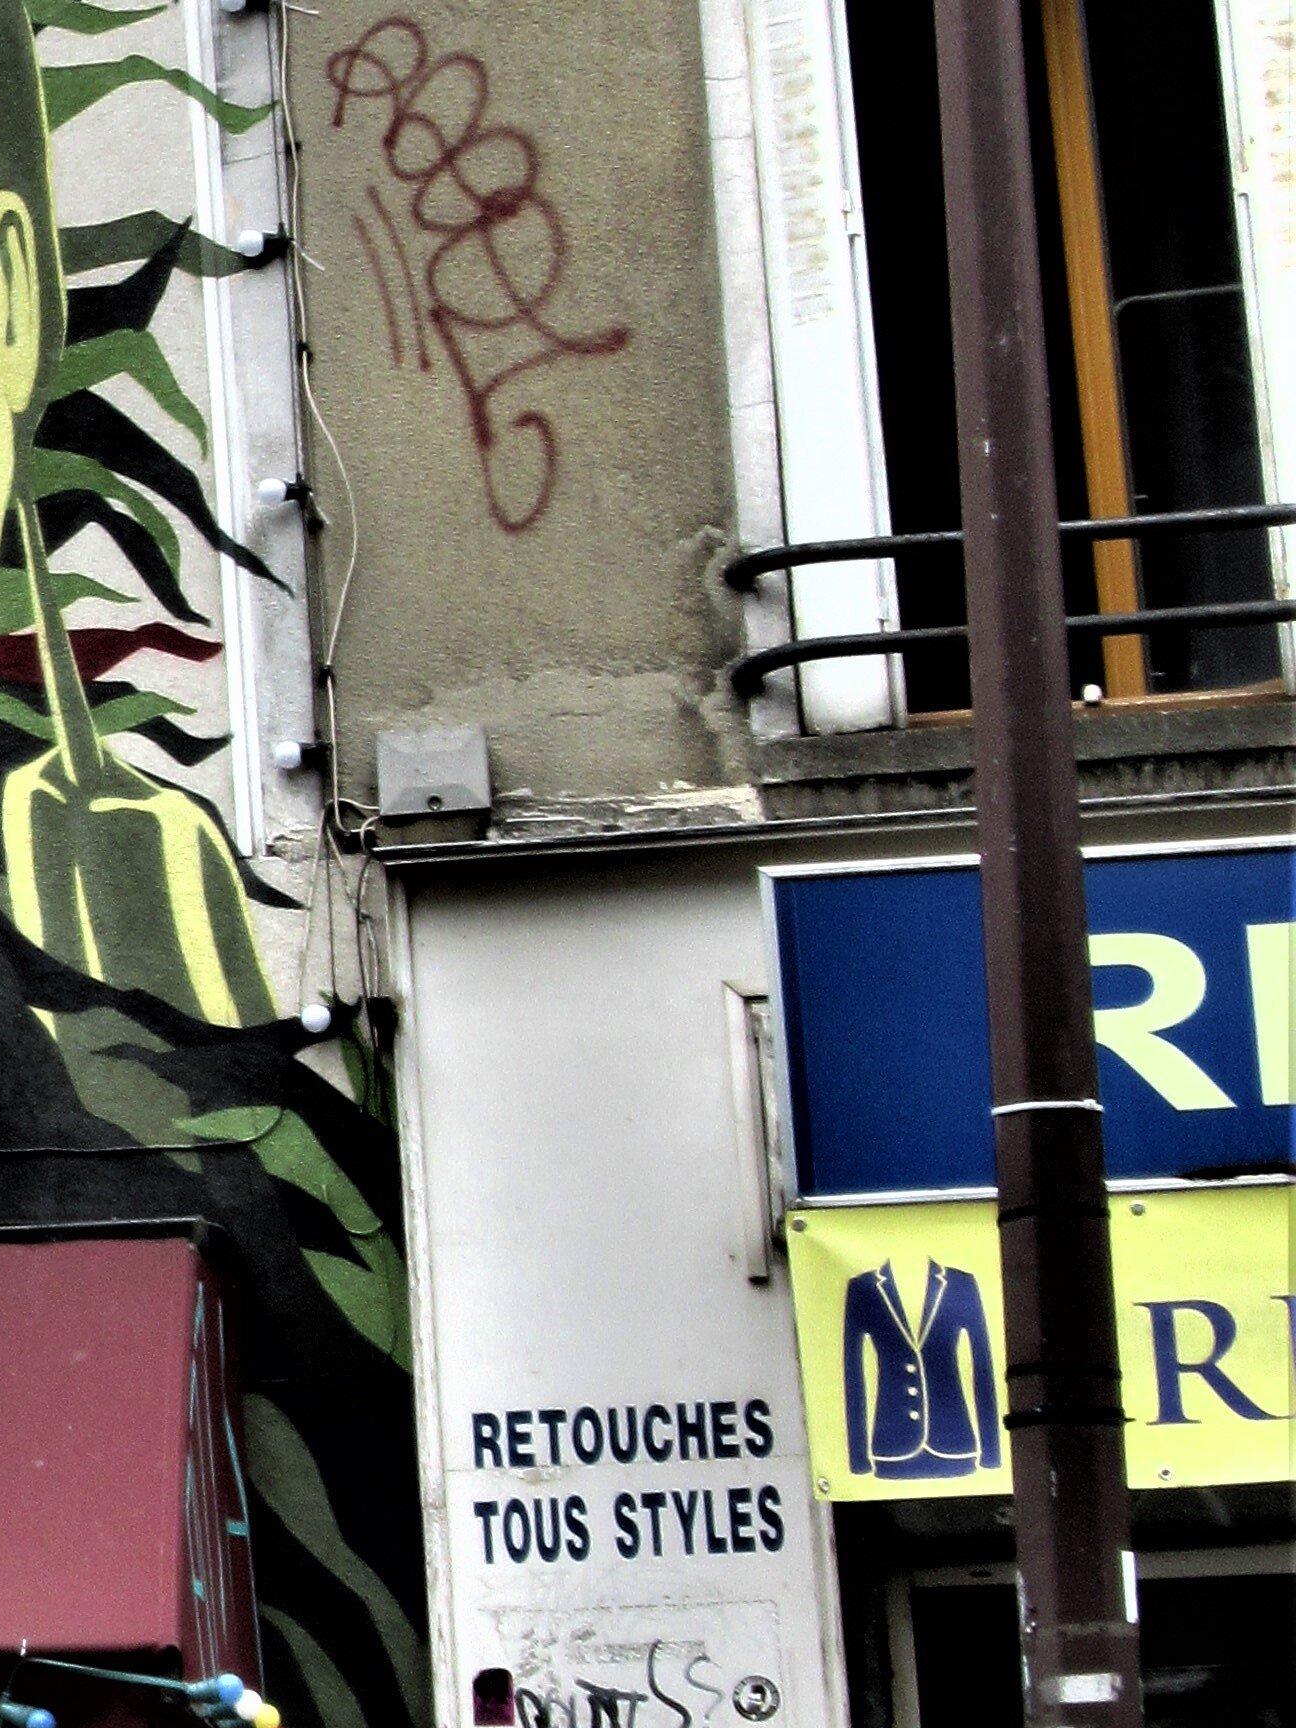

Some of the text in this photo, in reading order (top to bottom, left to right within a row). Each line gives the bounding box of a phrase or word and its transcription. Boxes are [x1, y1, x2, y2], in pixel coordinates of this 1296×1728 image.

[471, 1397, 775, 1469] RETOUCHES
[473, 1485, 785, 1564] TOUS STYLES
